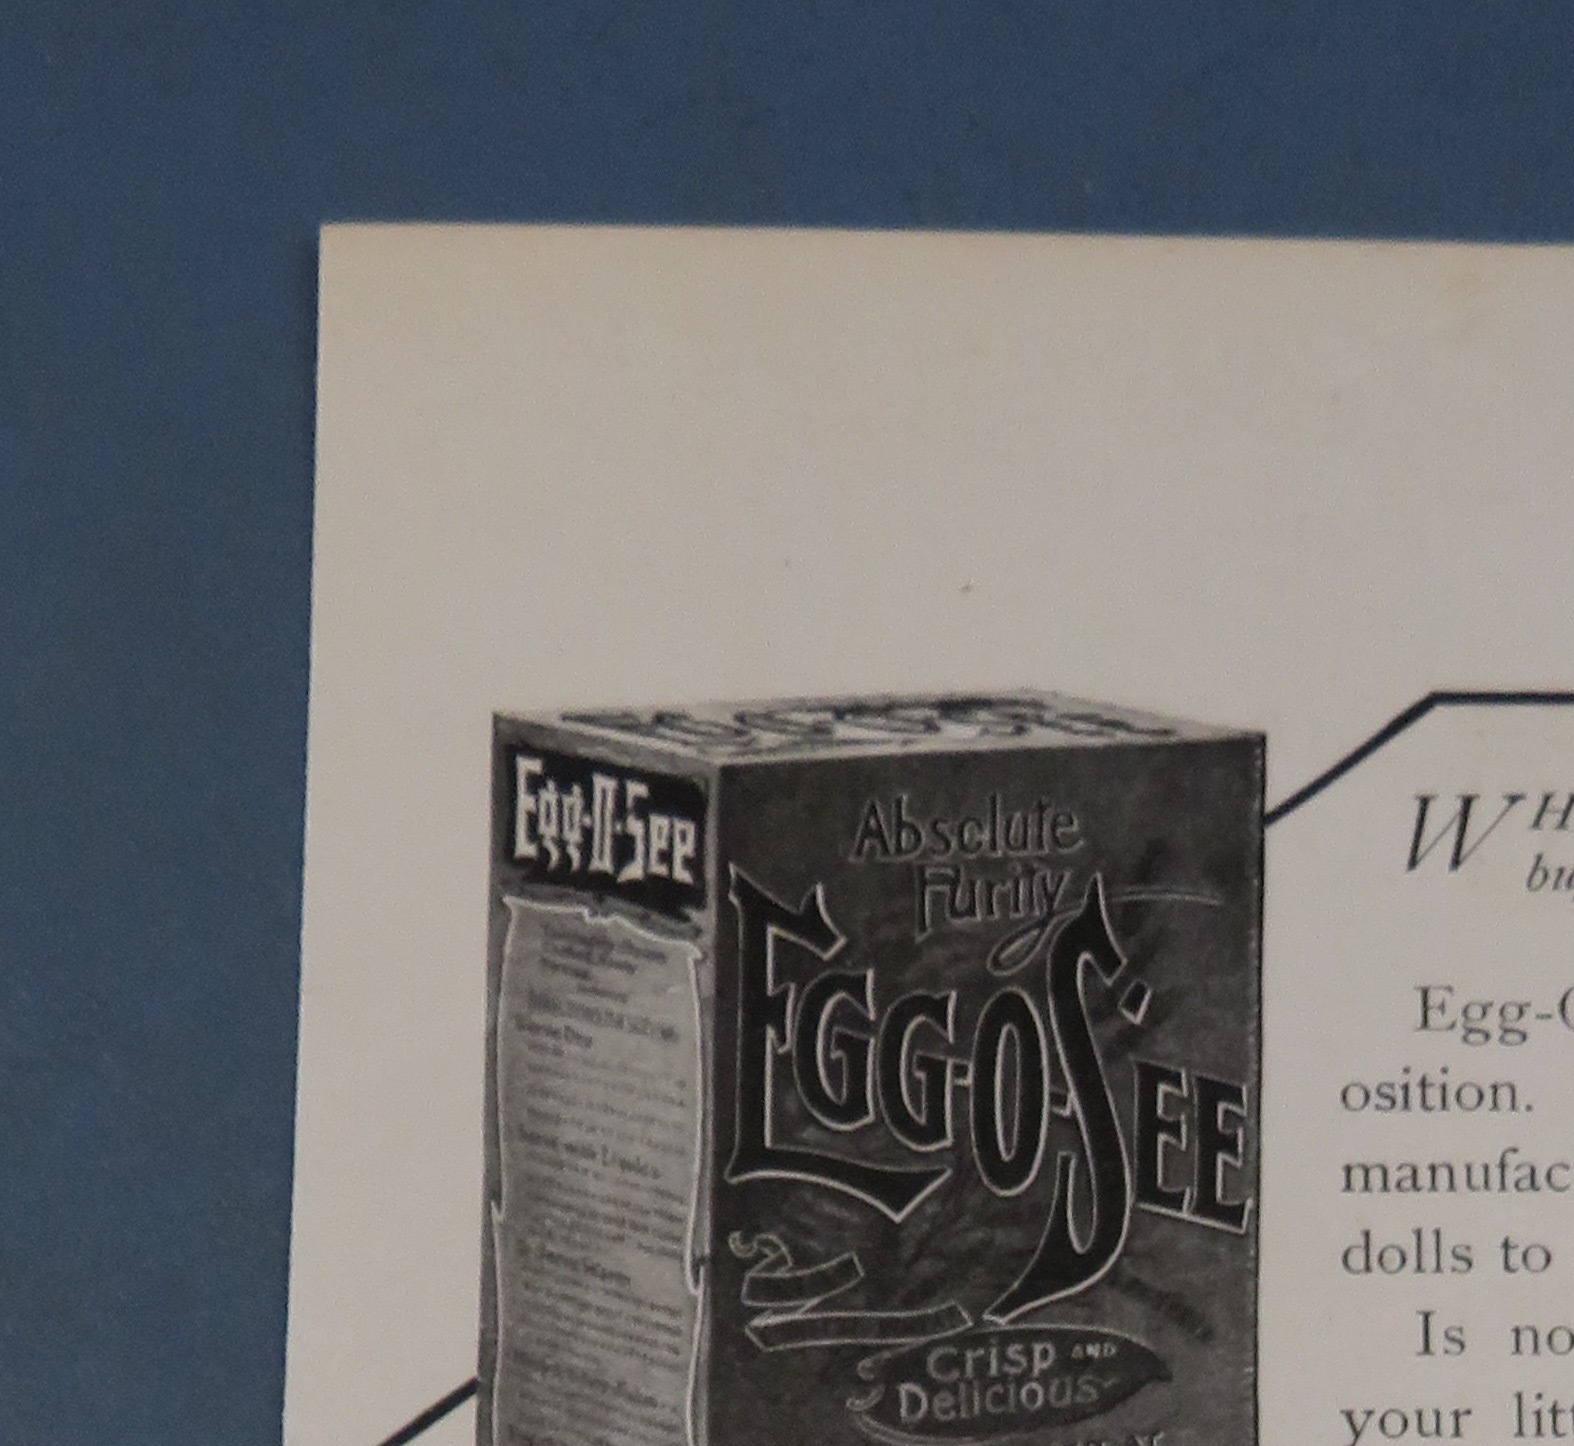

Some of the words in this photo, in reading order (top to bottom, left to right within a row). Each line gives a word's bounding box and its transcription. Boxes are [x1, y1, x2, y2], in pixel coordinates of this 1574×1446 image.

[1341, 1227, 1473, 1274] dolls
[1501, 1236, 1552, 1273] to
[927, 1340, 1057, 1381] Crisp
[899, 1374, 1101, 1424] Delicious
